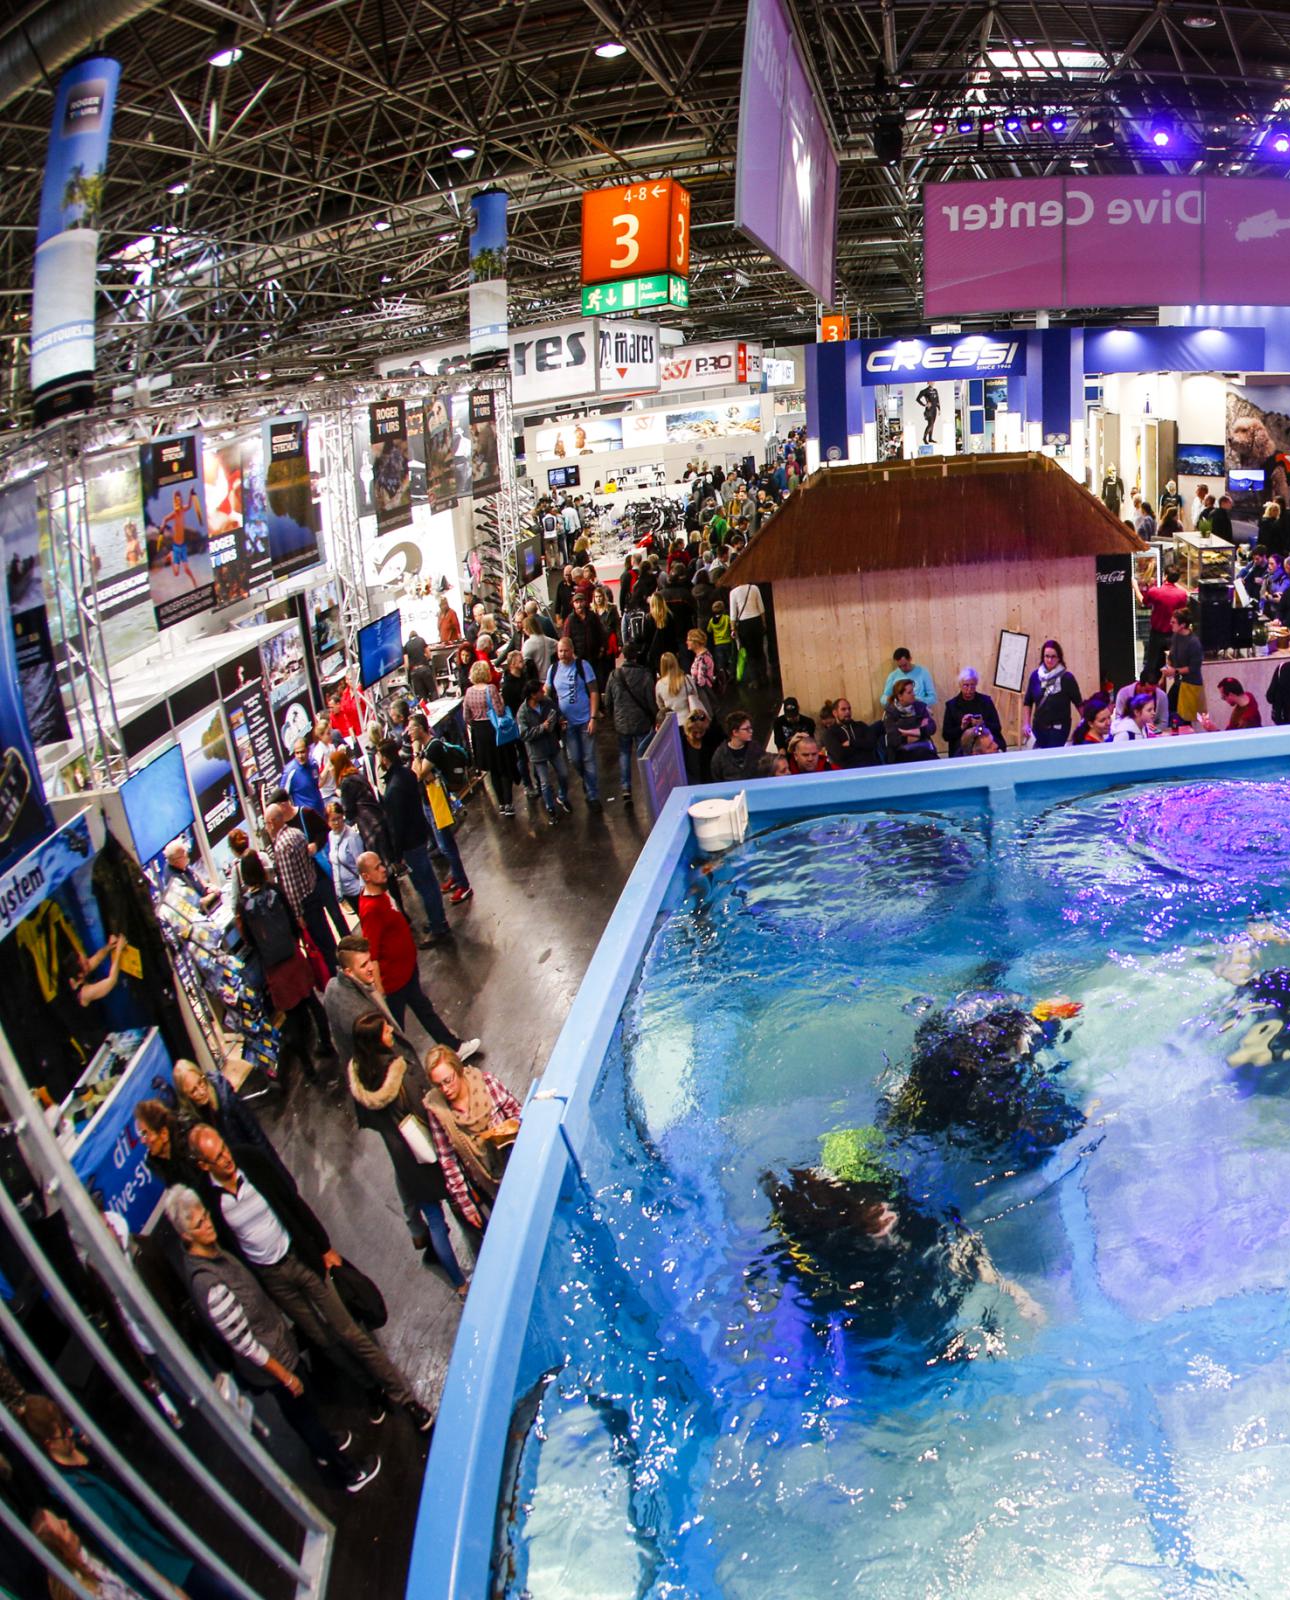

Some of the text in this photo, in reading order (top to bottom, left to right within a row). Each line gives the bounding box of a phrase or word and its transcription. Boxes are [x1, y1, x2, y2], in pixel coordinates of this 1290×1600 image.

[623, 186, 648, 203] 4-8
[610, 213, 639, 269] 3
[676, 213, 685, 266] 3
[615, 332, 654, 364] mares
[828, 325, 838, 342] 3
[866, 341, 1019, 373] CRESSI
[375, 406, 399, 420] ROGER
